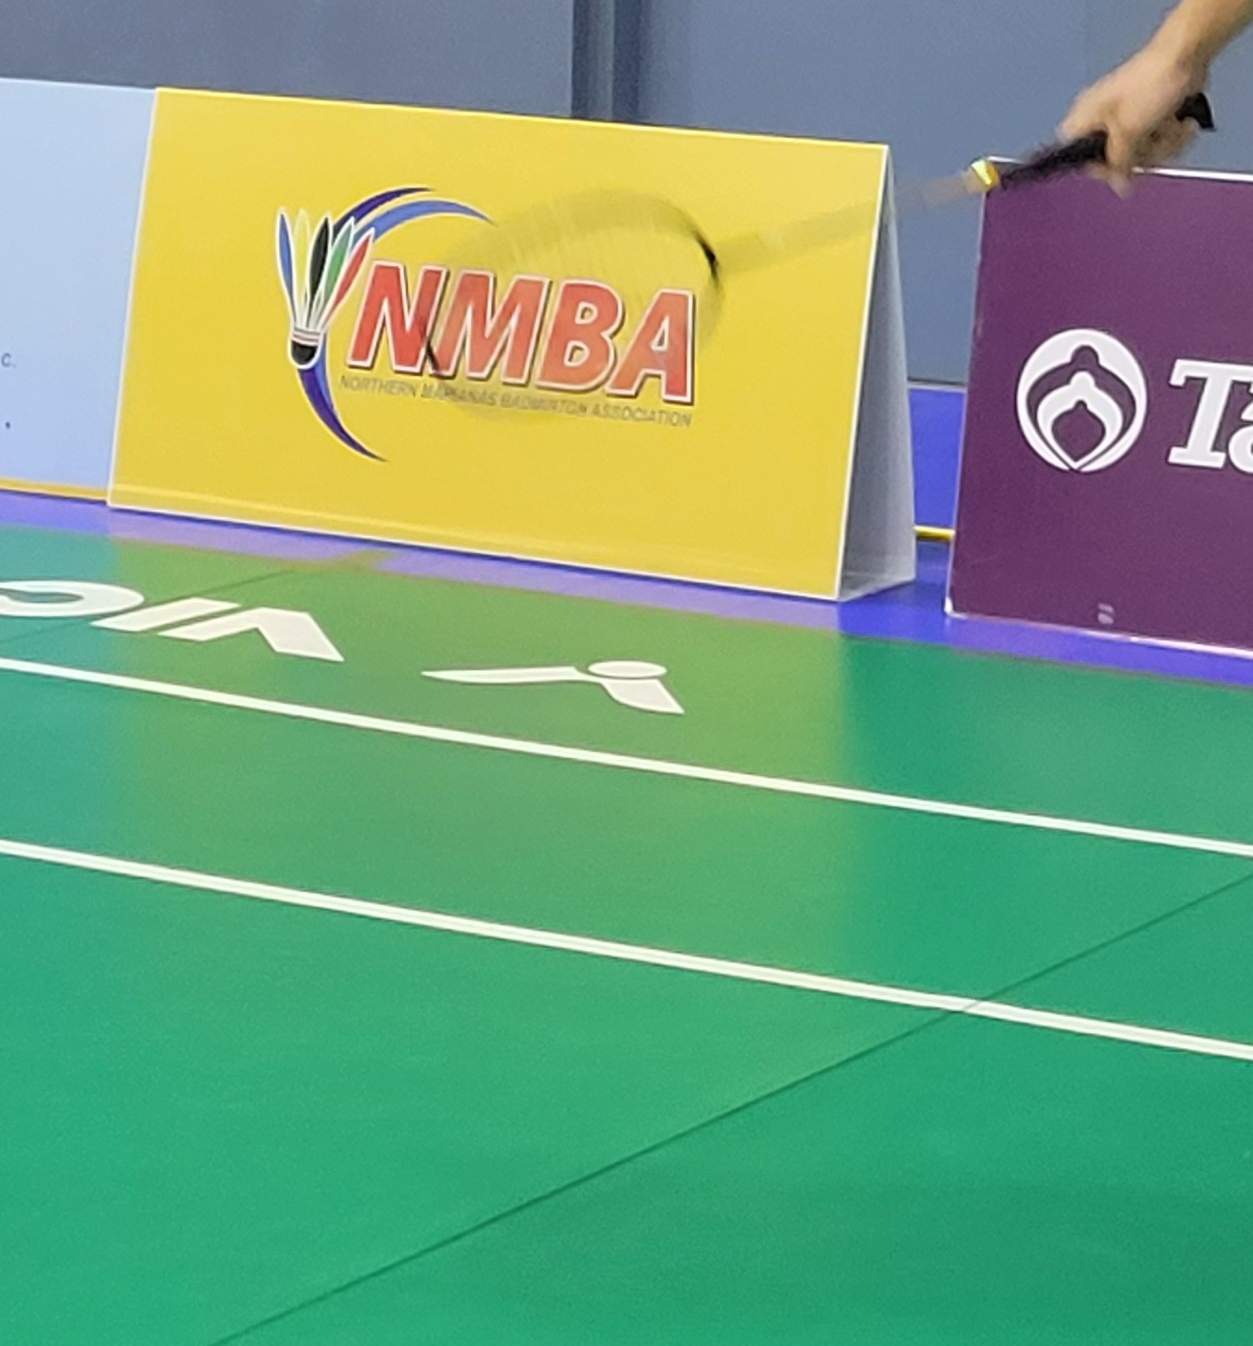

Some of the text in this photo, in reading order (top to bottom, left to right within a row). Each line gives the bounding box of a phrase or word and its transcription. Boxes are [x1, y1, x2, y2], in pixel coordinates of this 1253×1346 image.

[346, 259, 696, 406] NMBA
[340, 374, 416, 397] NORTHERN
[591, 401, 693, 428] ASSOCIATION
